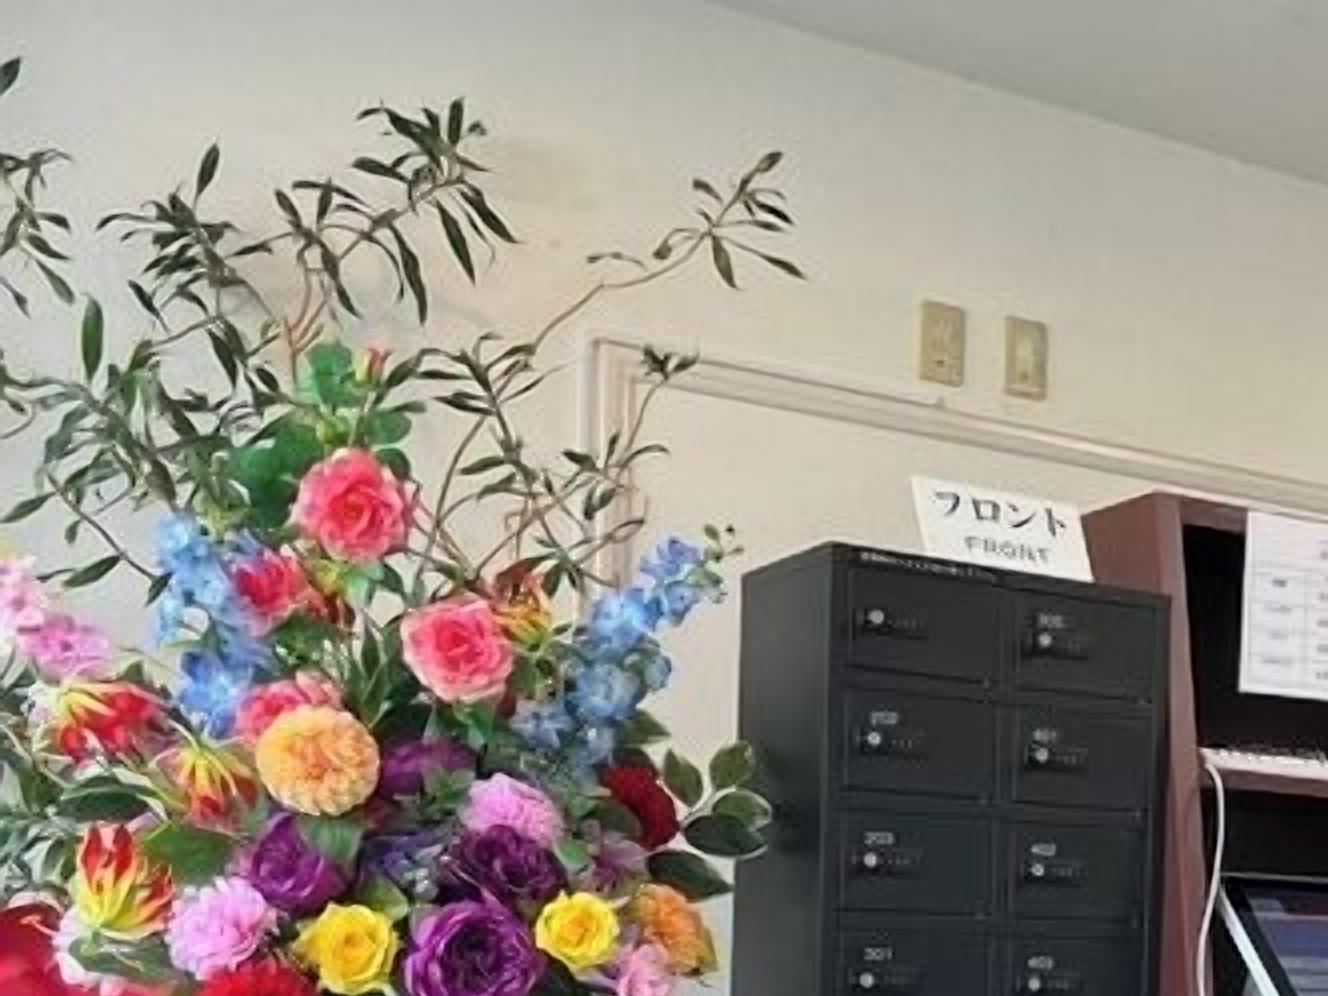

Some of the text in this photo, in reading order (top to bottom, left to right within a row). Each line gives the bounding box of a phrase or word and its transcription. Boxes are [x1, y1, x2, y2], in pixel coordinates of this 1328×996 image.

[932, 491, 1066, 537] フロント
[964, 535, 1050, 562] FRONT
